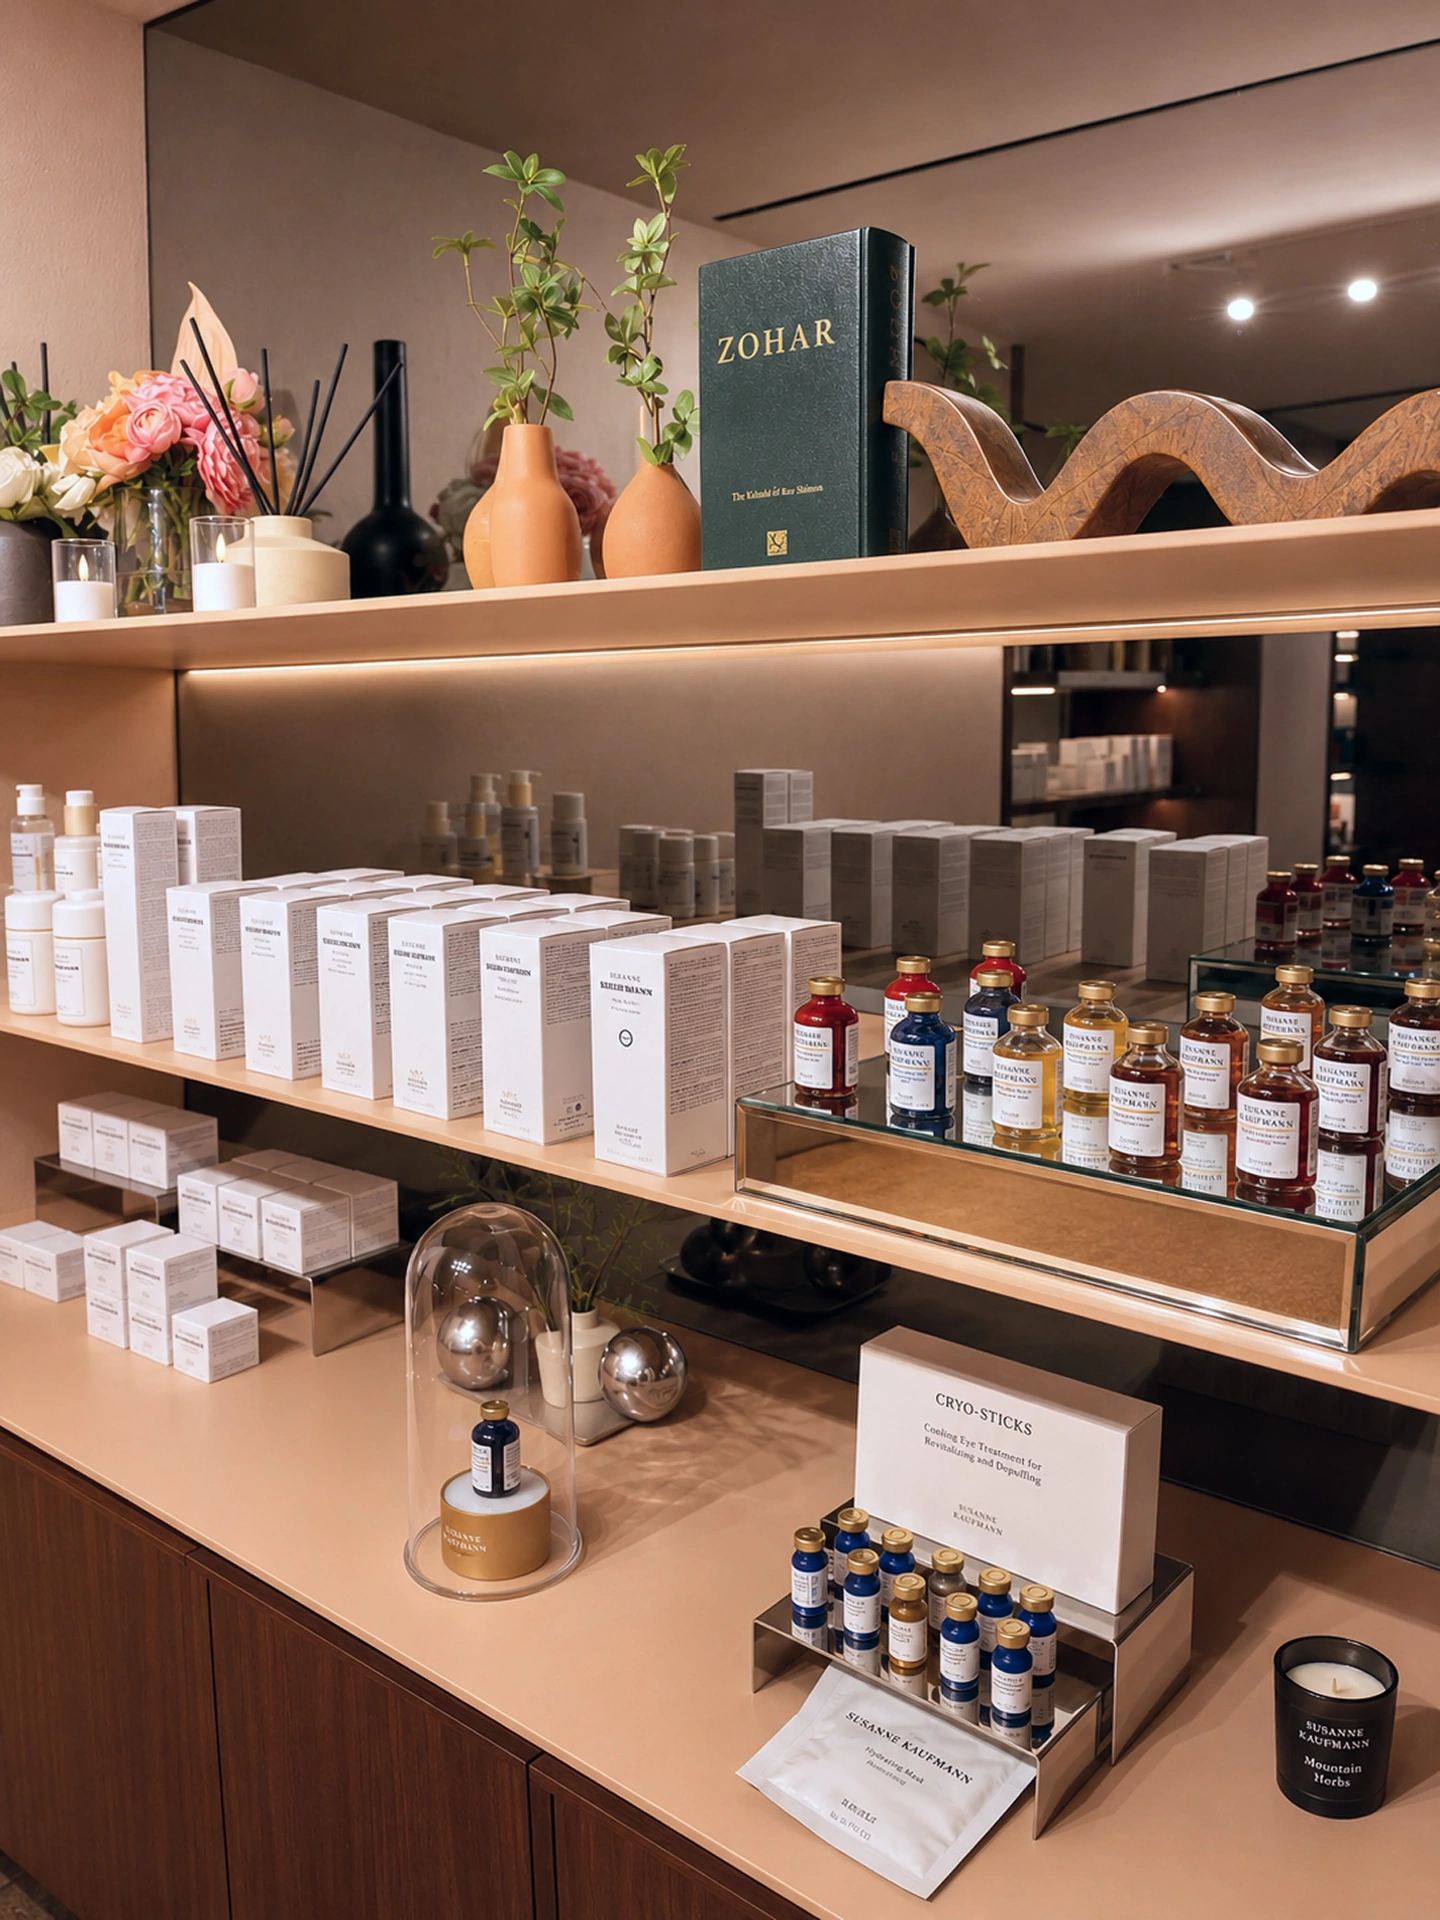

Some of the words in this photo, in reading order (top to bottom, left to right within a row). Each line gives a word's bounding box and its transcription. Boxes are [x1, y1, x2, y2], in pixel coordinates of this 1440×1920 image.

[717, 319, 836, 364] ZOHAR
[935, 1392, 1032, 1436] CRYO-STICKS
[924, 1422, 958, 1443] Cooling
[960, 1435, 977, 1448] Eye
[978, 1442, 1025, 1466] Treatment
[1028, 1458, 1042, 1471] for
[924, 1436, 975, 1463] Revitalizing
[977, 1456, 994, 1468] and
[996, 1461, 1042, 1487] Depuffing
[845, 1711, 901, 1744] SUSANNE
[901, 1740, 973, 1785] KAUFMANN
[1298, 1729, 1370, 1750] KAUFMANN
[1306, 1720, 1364, 1737] SUSANNE
[1304, 1755, 1362, 1774] Mountain
[1314, 1772, 1351, 1788] Herbs
